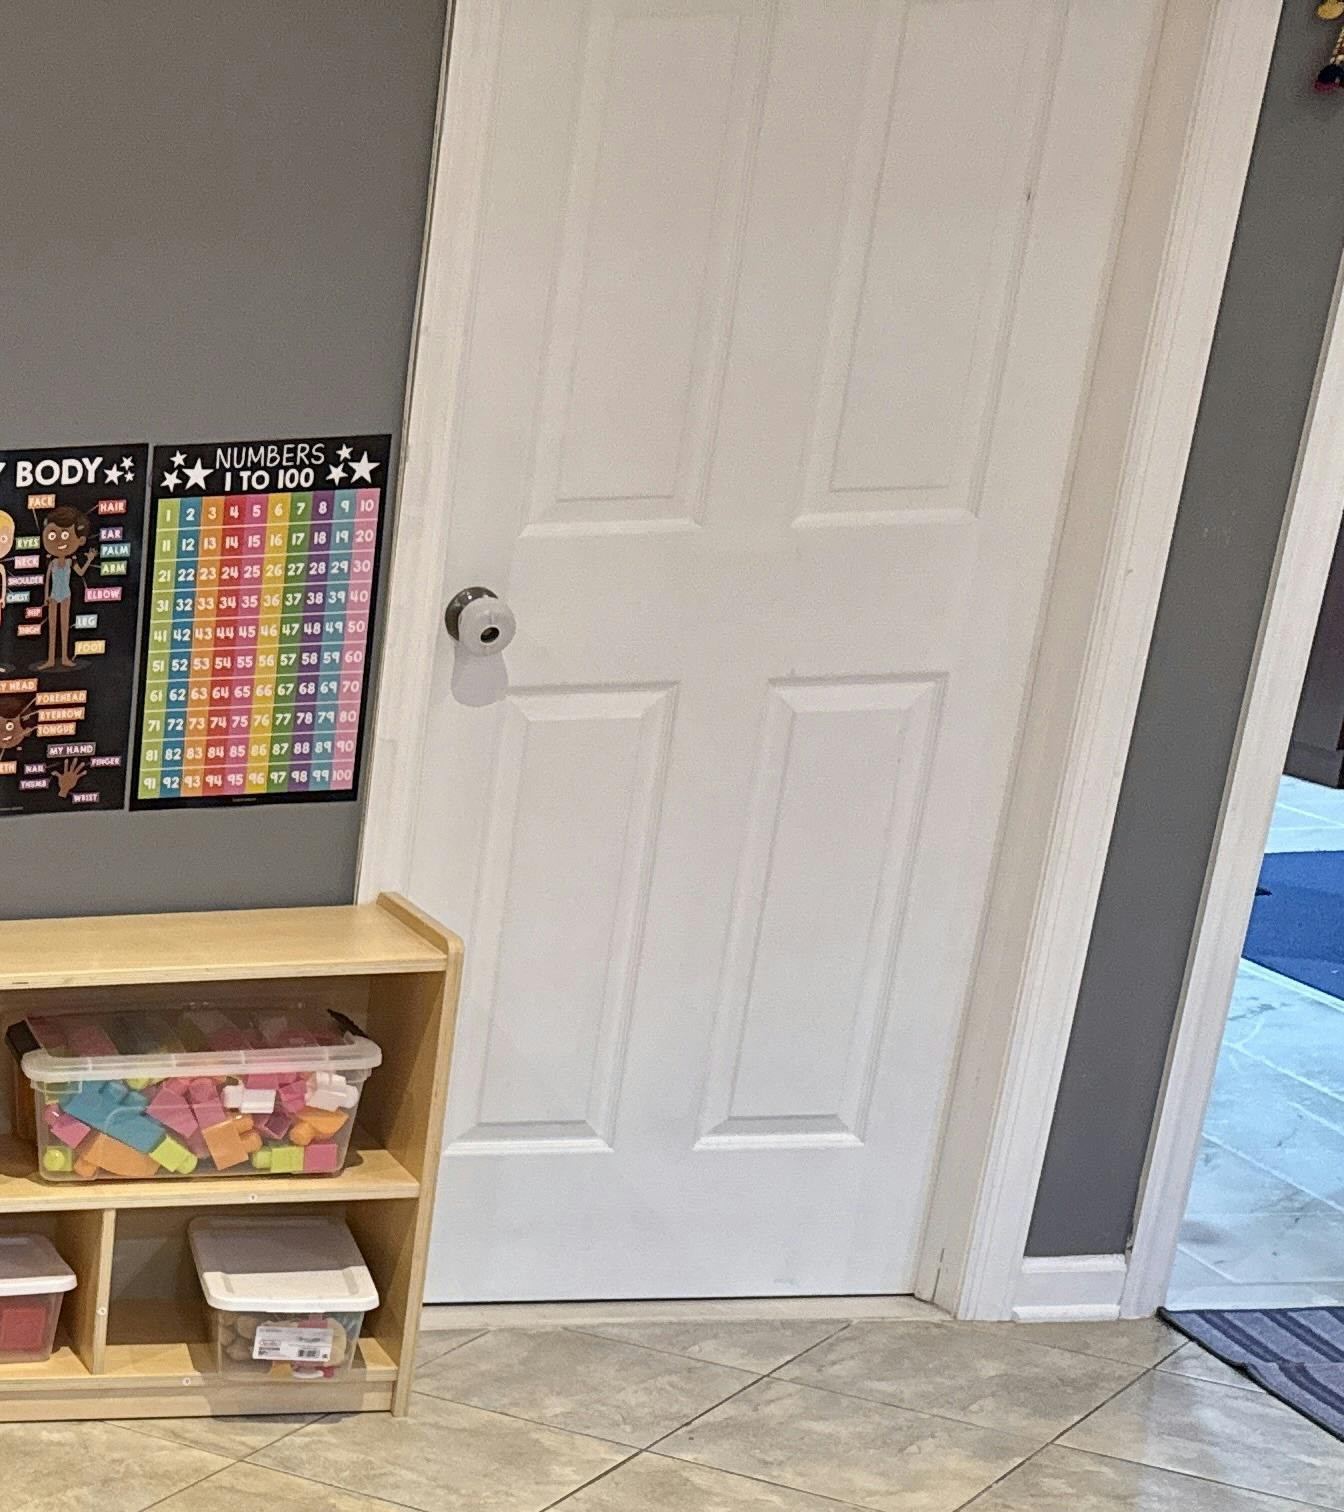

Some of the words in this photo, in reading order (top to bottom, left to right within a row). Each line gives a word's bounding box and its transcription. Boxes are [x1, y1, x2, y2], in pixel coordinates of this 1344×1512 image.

[215, 443, 325, 470] NUMBERS
[16, 457, 103, 488] BODY
[240, 471, 270, 491] TO
[277, 468, 314, 489] 100
[102, 546, 128, 556] PALM
